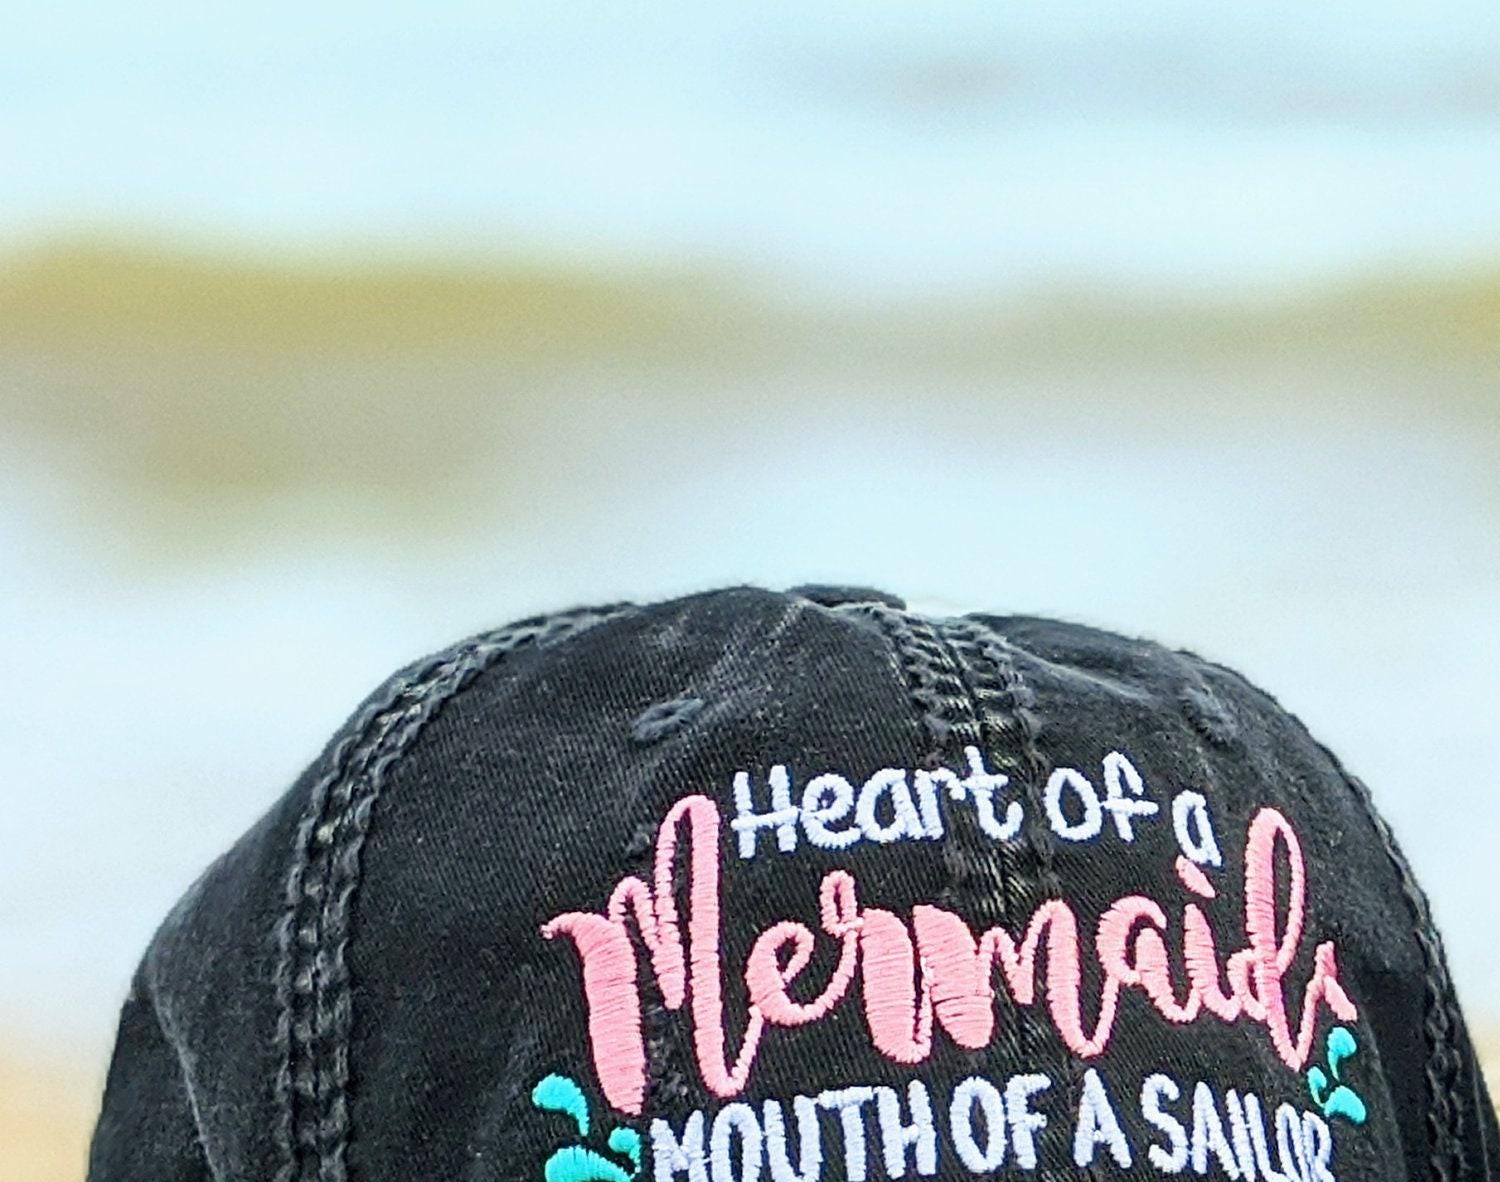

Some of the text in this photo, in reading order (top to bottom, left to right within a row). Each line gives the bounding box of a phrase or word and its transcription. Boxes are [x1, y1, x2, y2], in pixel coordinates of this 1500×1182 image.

[732, 747, 1222, 866] Heart of a
[540, 794, 1359, 1115] Mermaid
[950, 1074, 1051, 1172] OF
[1074, 1068, 1131, 1168] A
